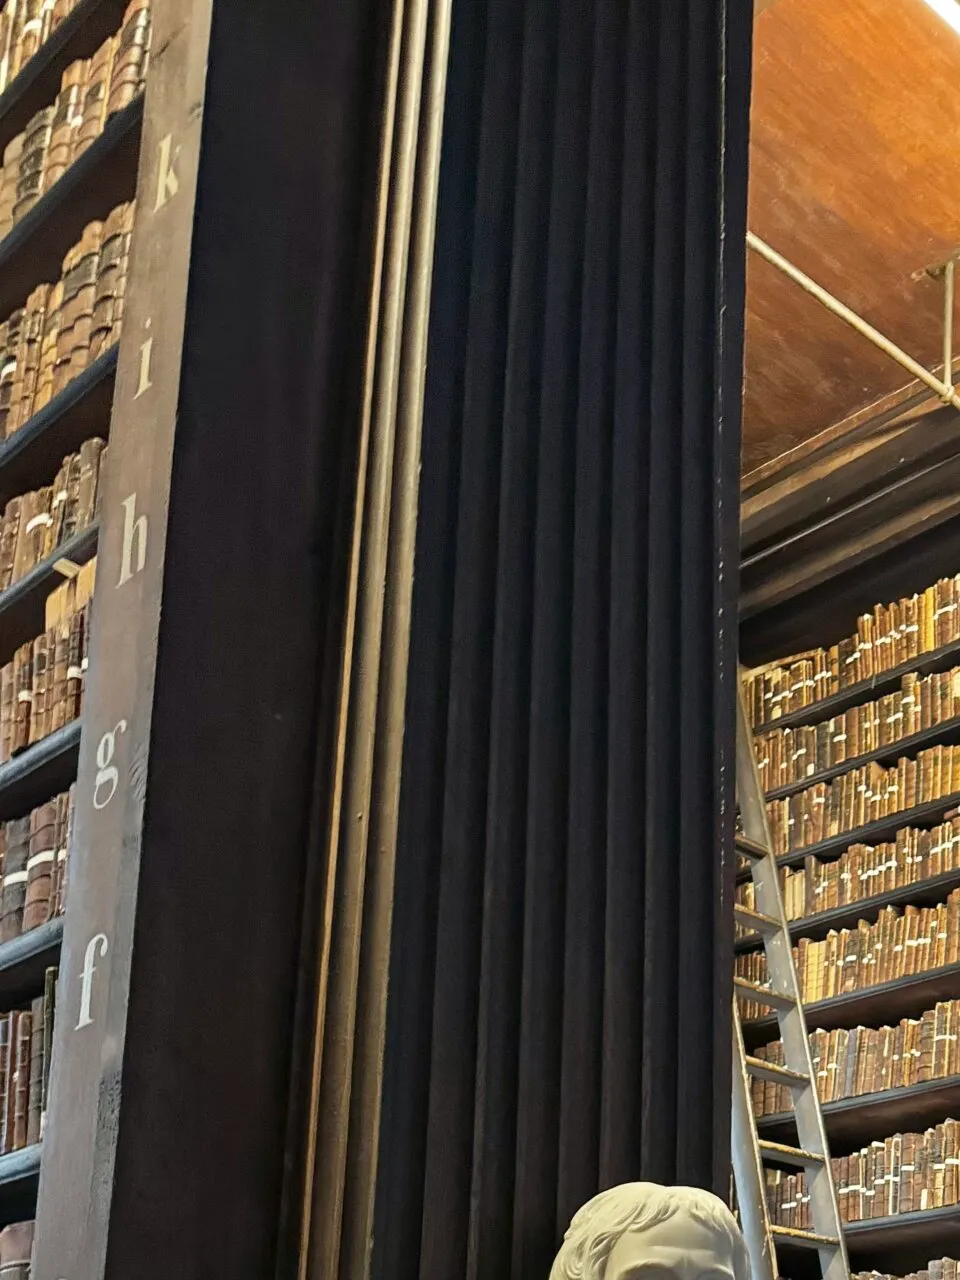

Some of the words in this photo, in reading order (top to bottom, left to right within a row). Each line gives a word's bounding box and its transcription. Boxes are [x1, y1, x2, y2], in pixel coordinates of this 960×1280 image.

[153, 133, 181, 214] k
[134, 318, 152, 399] i
[116, 493, 147, 589] h
[93, 720, 126, 809] g
[75, 934, 107, 1030] f
